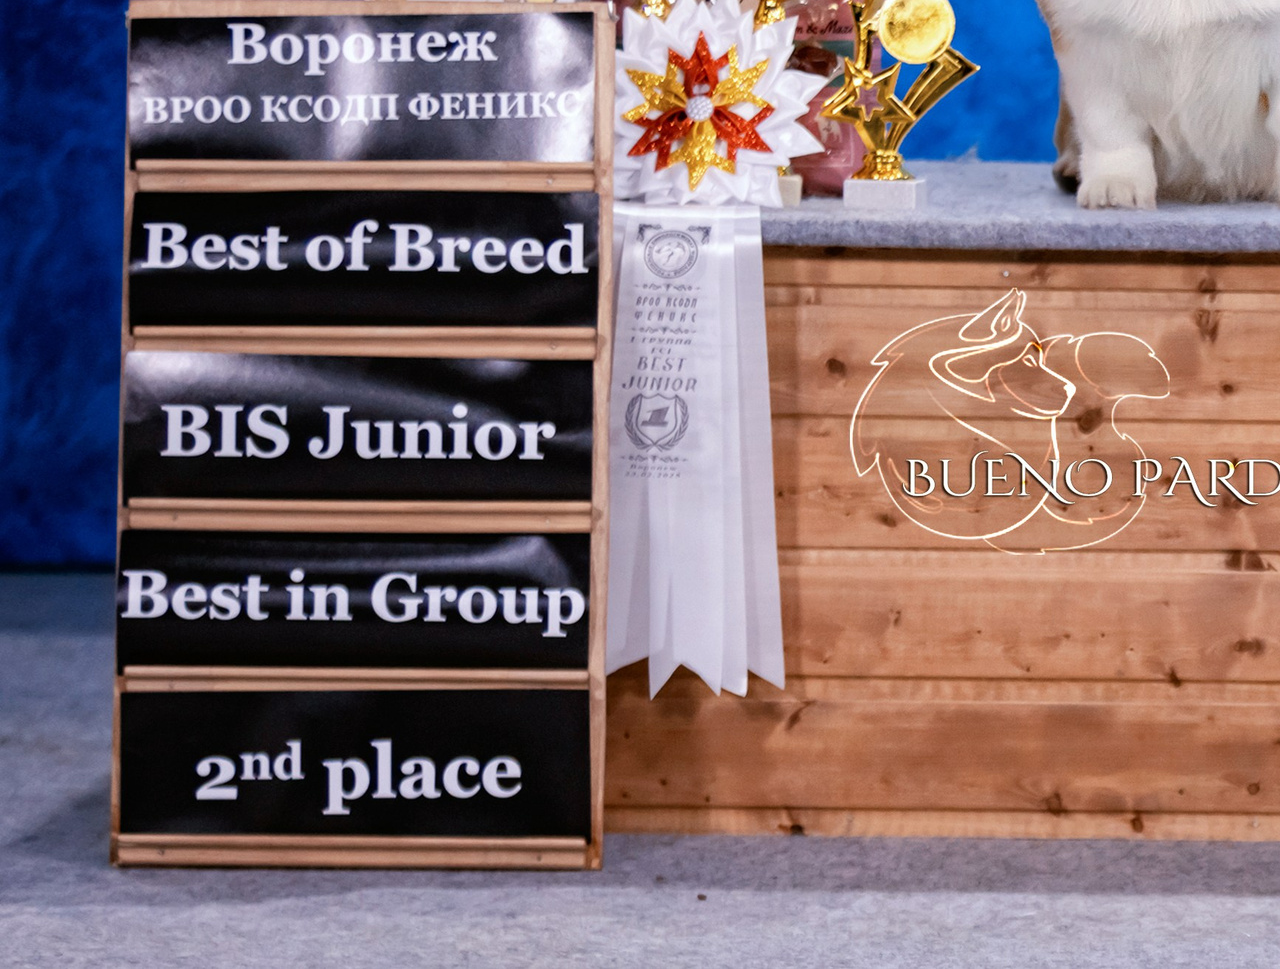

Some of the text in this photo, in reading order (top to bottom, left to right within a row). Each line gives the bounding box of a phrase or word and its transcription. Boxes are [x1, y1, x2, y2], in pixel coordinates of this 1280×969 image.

[226, 21, 499, 77] Воронеж
[143, 87, 586, 128] ВРОО КСОДП ФЕНИКС
[140, 222, 288, 271] Best
[305, 219, 379, 272] of
[388, 223, 589, 275] Breed
[622, 375, 698, 393] JUNIOR
[637, 355, 687, 372] BEST
[160, 403, 556, 460] BIS Junior
[121, 568, 585, 638] Best in Group
[195, 738, 523, 816] 2nd place
